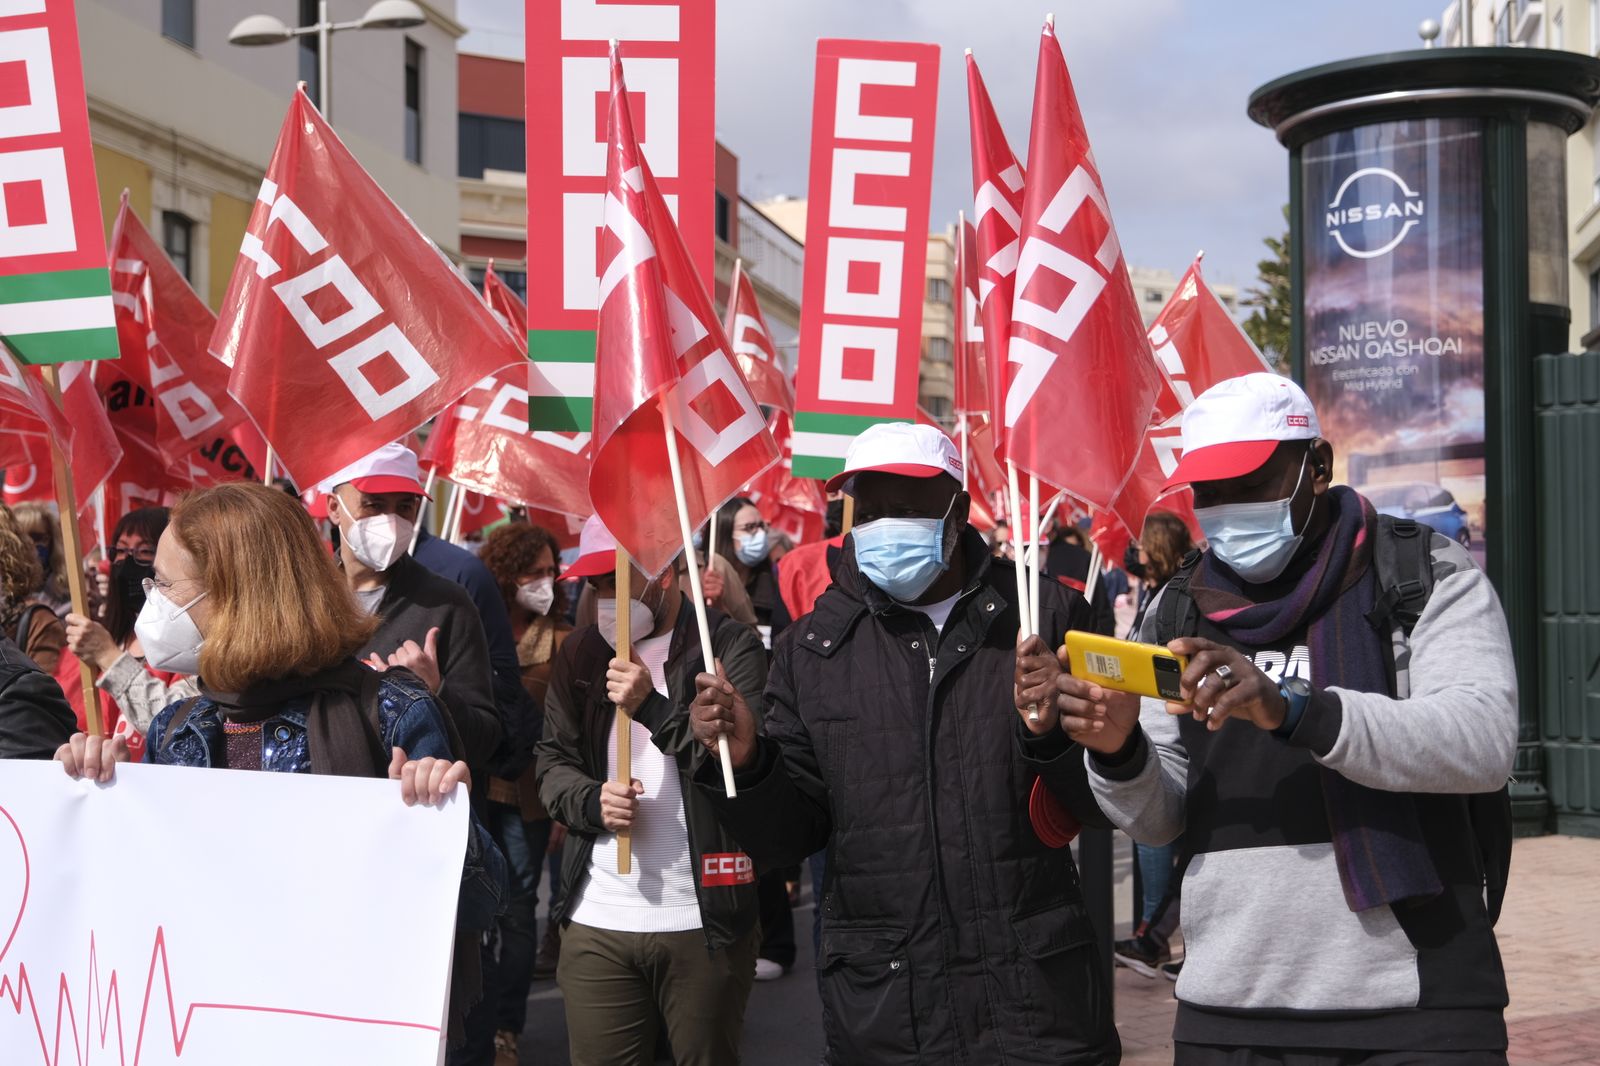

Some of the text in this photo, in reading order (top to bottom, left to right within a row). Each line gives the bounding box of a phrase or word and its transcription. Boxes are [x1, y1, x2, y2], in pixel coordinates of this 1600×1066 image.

[1326, 200, 1424, 228] NISSAN
[818, 58, 917, 405] CCOO
[1339, 319, 1409, 342] NUEVO
[1310, 337, 1463, 366] NISSAN QASHQAI
